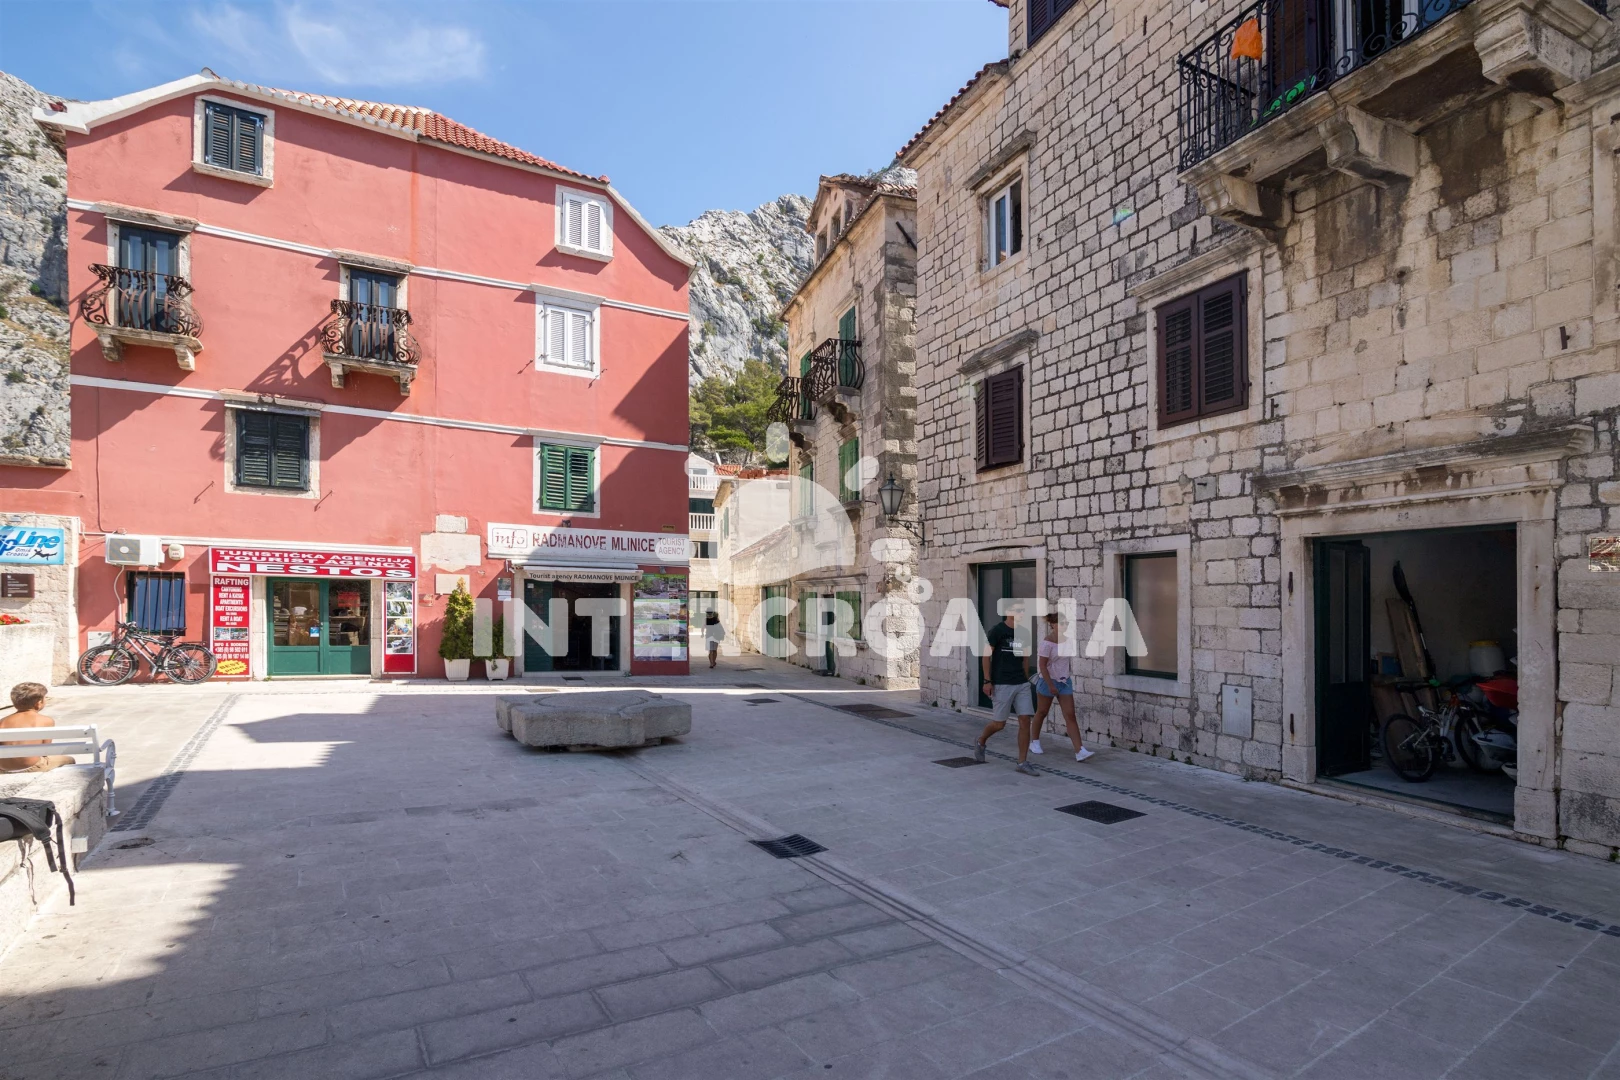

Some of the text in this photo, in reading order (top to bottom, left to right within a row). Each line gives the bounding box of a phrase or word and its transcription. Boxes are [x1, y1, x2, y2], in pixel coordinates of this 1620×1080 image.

[15, 531, 60, 549] Line
[494, 531, 526, 548] info
[532, 531, 655, 553] RADMANOVE MLINICE
[658, 537, 686, 546] TOURIST
[217, 550, 412, 564] TURISTIČKA AGENCIJA
[658, 547, 685, 555] AGENCY
[219, 555, 411, 568] TOURIST AGENCY
[216, 562, 412, 578] NESTOS
[214, 577, 249, 586] RAFTING
